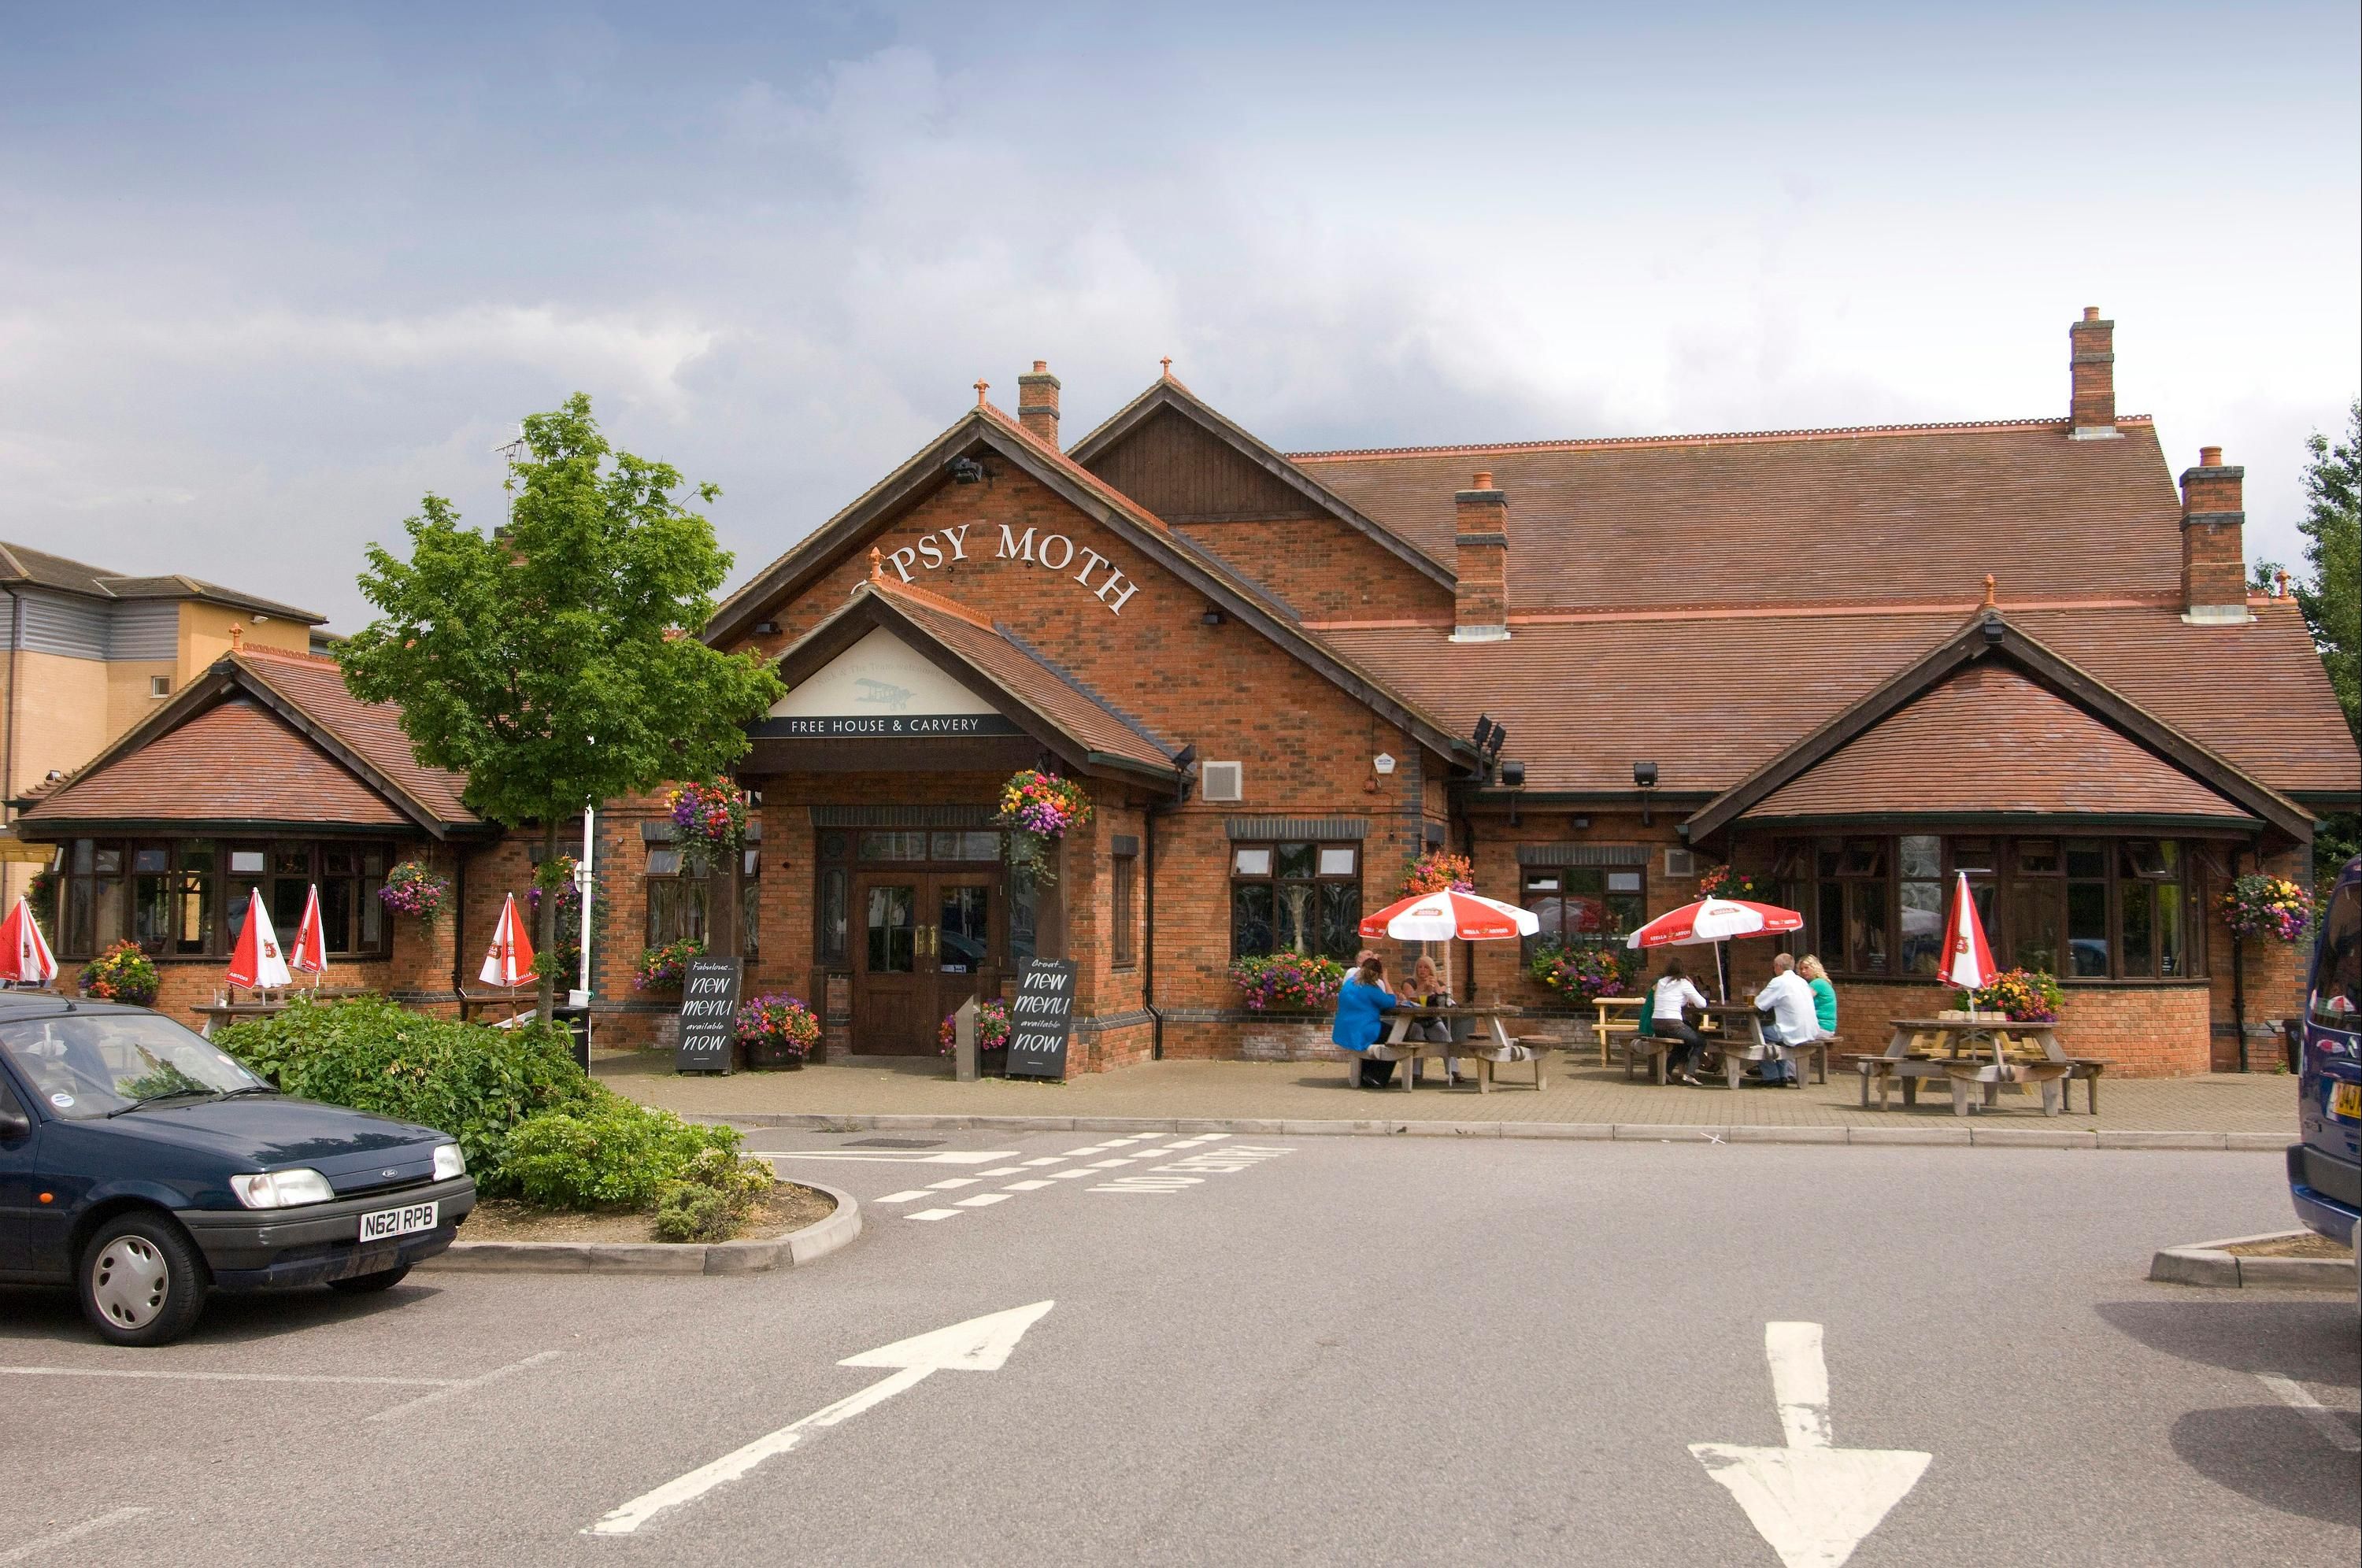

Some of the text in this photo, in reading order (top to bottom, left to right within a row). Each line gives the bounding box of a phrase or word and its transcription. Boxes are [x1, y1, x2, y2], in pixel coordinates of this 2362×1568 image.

[850, 524, 1139, 616] PSY MOTH
[791, 719, 979, 733] FREE HOUSE & CARVERY
[229, 972, 249, 982] ARTOIS
[516, 971, 532, 982] STELLA
[1024, 972, 1068, 990] new
[690, 977, 731, 993] new
[681, 1000, 733, 1016] menu
[1013, 995, 1071, 1015] menu
[686, 1022, 724, 1030] available
[1020, 1019, 1061, 1028] available
[683, 1035, 727, 1051] now
[1013, 1033, 1062, 1053] now
[1084, 1145, 1298, 1193] NO ENTRY
[365, 1205, 433, 1237] N621 RPB
